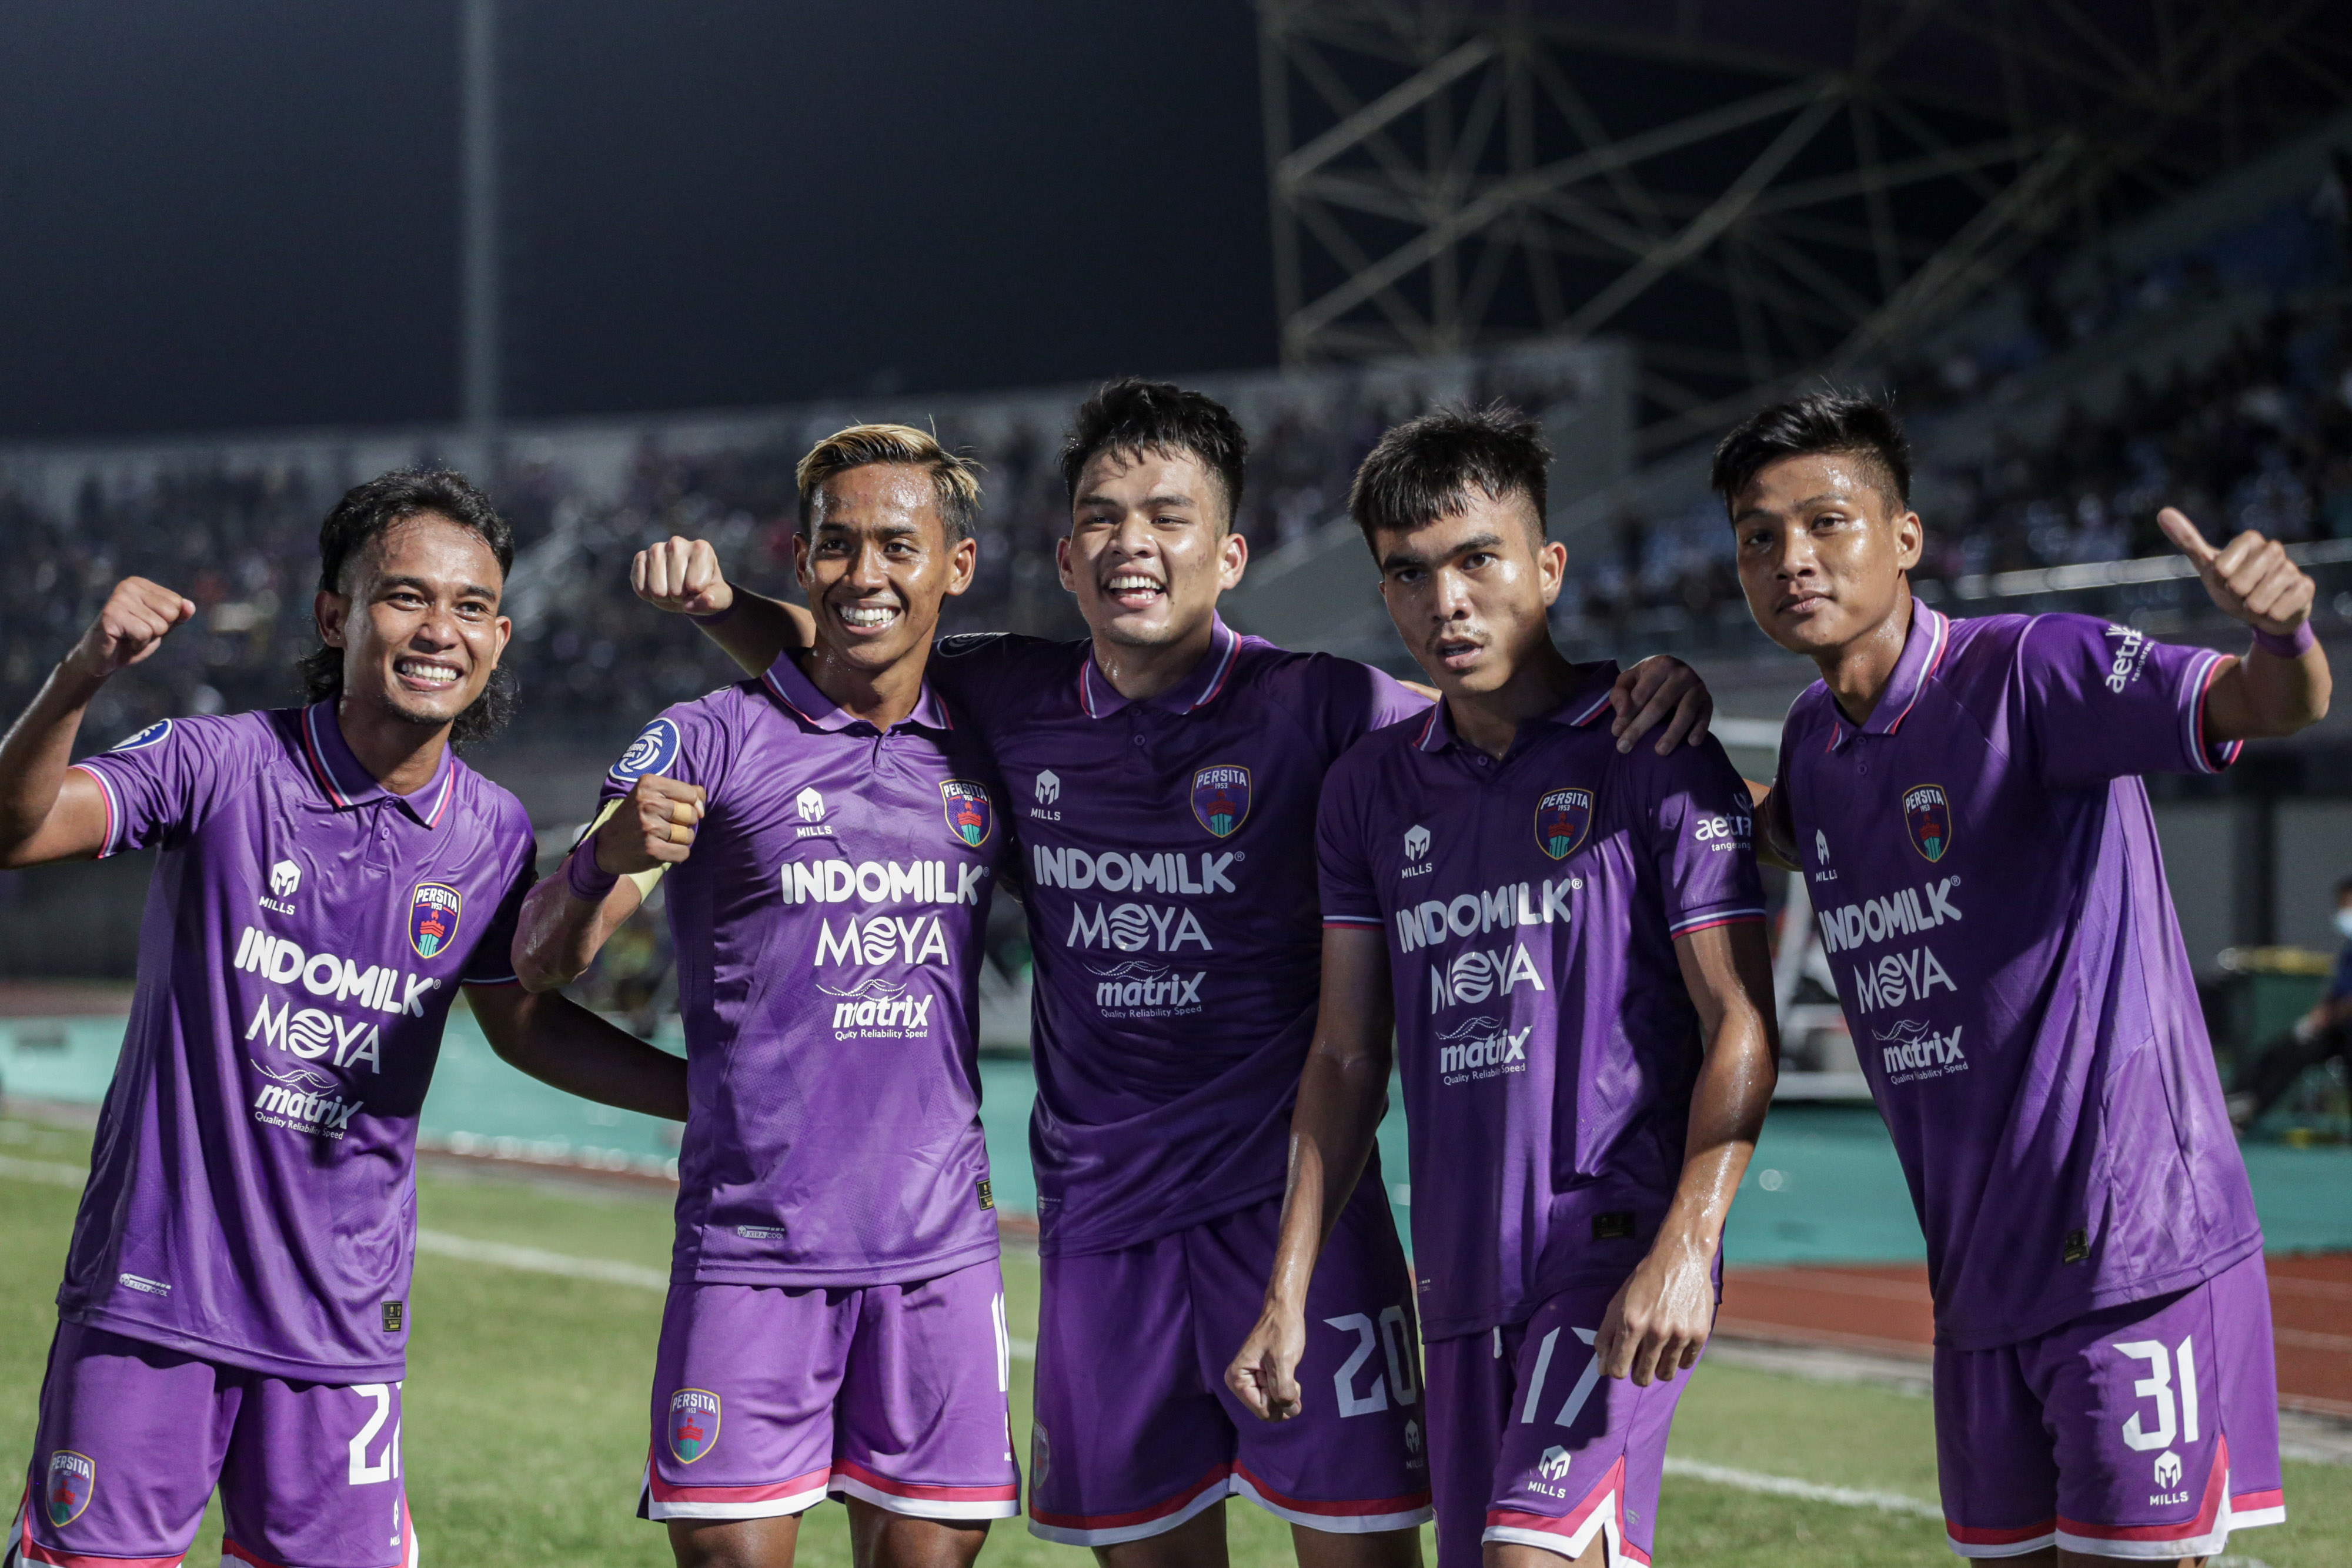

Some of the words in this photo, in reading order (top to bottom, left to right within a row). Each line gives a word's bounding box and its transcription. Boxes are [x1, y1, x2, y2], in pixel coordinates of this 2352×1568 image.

[2106, 631, 2142, 693] aetr
[2132, 641, 2155, 682] tangeran
[1197, 769, 1247, 788] PERSITA
[943, 783, 987, 802] PERSITA
[1541, 792, 1588, 810] PERSITA
[1906, 790, 1944, 814] PERSITA
[1030, 808, 1061, 821] MILLS
[1920, 804, 1930, 813] 1953
[796, 825, 833, 837] MILLS
[1712, 842, 1751, 851] tangerang
[1402, 862, 1432, 878] MILLS
[1816, 869, 1838, 882] MILLS
[259, 896, 295, 915] MILLS
[416, 888, 457, 912] PERSITA
[430, 901, 443, 911] 1953
[1067, 901, 1213, 952] MOYA
[814, 916, 949, 967] MOYA
[1096, 971, 1207, 1007] matrix
[1431, 942, 1545, 1014] MOYA
[1853, 945, 1957, 1014] MOYA
[833, 995, 933, 1029] matrix
[1101, 1009, 1126, 1019] Quality
[1130, 1009, 1171, 1018] Reliability
[1174, 1005, 1202, 1015] Speed
[245, 994, 380, 1074] MOYA
[861, 1029, 903, 1039] Reliability
[905, 1029, 927, 1039] Speed
[1441, 1025, 1533, 1074] matrix
[1883, 1025, 1965, 1073] matrix
[1444, 1074, 1469, 1086] Quality
[1501, 1063, 1525, 1074] Speed
[1891, 1072, 1914, 1085] Quality
[1944, 1061, 1969, 1073] Speed
[254, 1084, 364, 1129] matrix
[255, 1111, 286, 1128] Quality
[288, 1120, 320, 1136] Reliability
[323, 1129, 344, 1140] Speed
[132, 1282, 148, 1291] XTRA
[151, 1287, 168, 1297] COOL
[1322, 1305, 1417, 1418] 20
[1521, 1326, 1601, 1427] 17
[673, 1393, 716, 1413] PERSITA
[2112, 1335, 2199, 1451] 31
[51, 1455, 89, 1479] PERSITA
[1528, 1480, 1566, 1499] MILLS
[2150, 1490, 2189, 1506] MILLS
